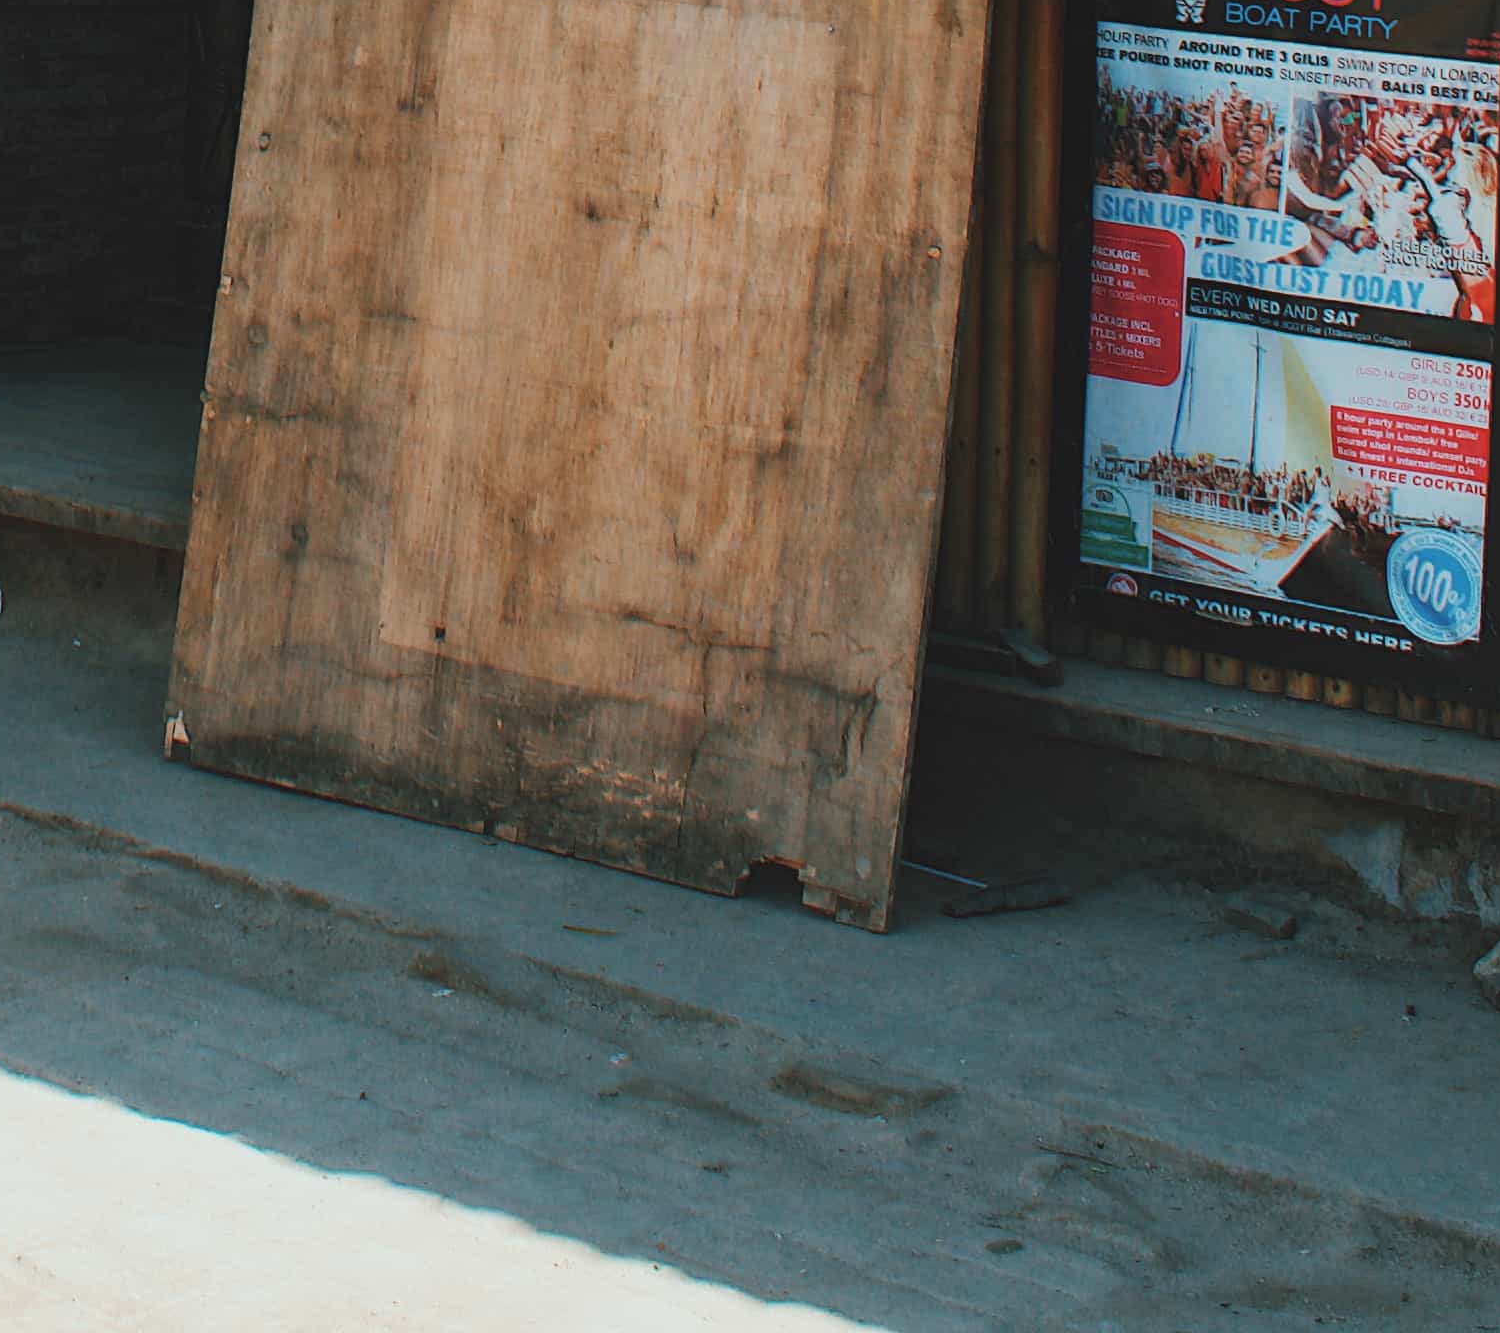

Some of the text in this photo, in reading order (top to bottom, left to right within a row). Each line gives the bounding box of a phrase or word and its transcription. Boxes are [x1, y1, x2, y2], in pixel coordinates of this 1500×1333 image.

[1225, 1, 1398, 41] BOAT PARTY
[1119, 49, 1170, 66] POURED
[1173, 57, 1209, 71] SHOT
[1214, 61, 1273, 78] ROUNDS
[1279, 68, 1329, 85] SUNSET
[1381, 80, 1425, 95] BALIS
[1430, 86, 1469, 101] BEST
[1134, 33, 1168, 49] PARTY
[1179, 40, 1241, 58] AROUND
[1246, 47, 1274, 63] THE
[1279, 51, 1288, 63] 3
[1292, 53, 1329, 67] GILIS
[1379, 62, 1418, 78] STOP
[1422, 66, 1436, 79] IN
[1102, 194, 1293, 247] SIGN UP FOR THE
[1201, 252, 1268, 287] GUEST
[1339, 274, 1425, 310] TODAY
[1190, 287, 1242, 306] EVERY
[1246, 296, 1280, 315] WED
[1282, 303, 1318, 321] AND
[1322, 309, 1360, 327] SAT
[1411, 357, 1451, 374] GIRLS
[1408, 387, 1449, 404] BOYS
[1370, 469, 1407, 484] FREE
[1412, 475, 1488, 497] COCKTAIL
